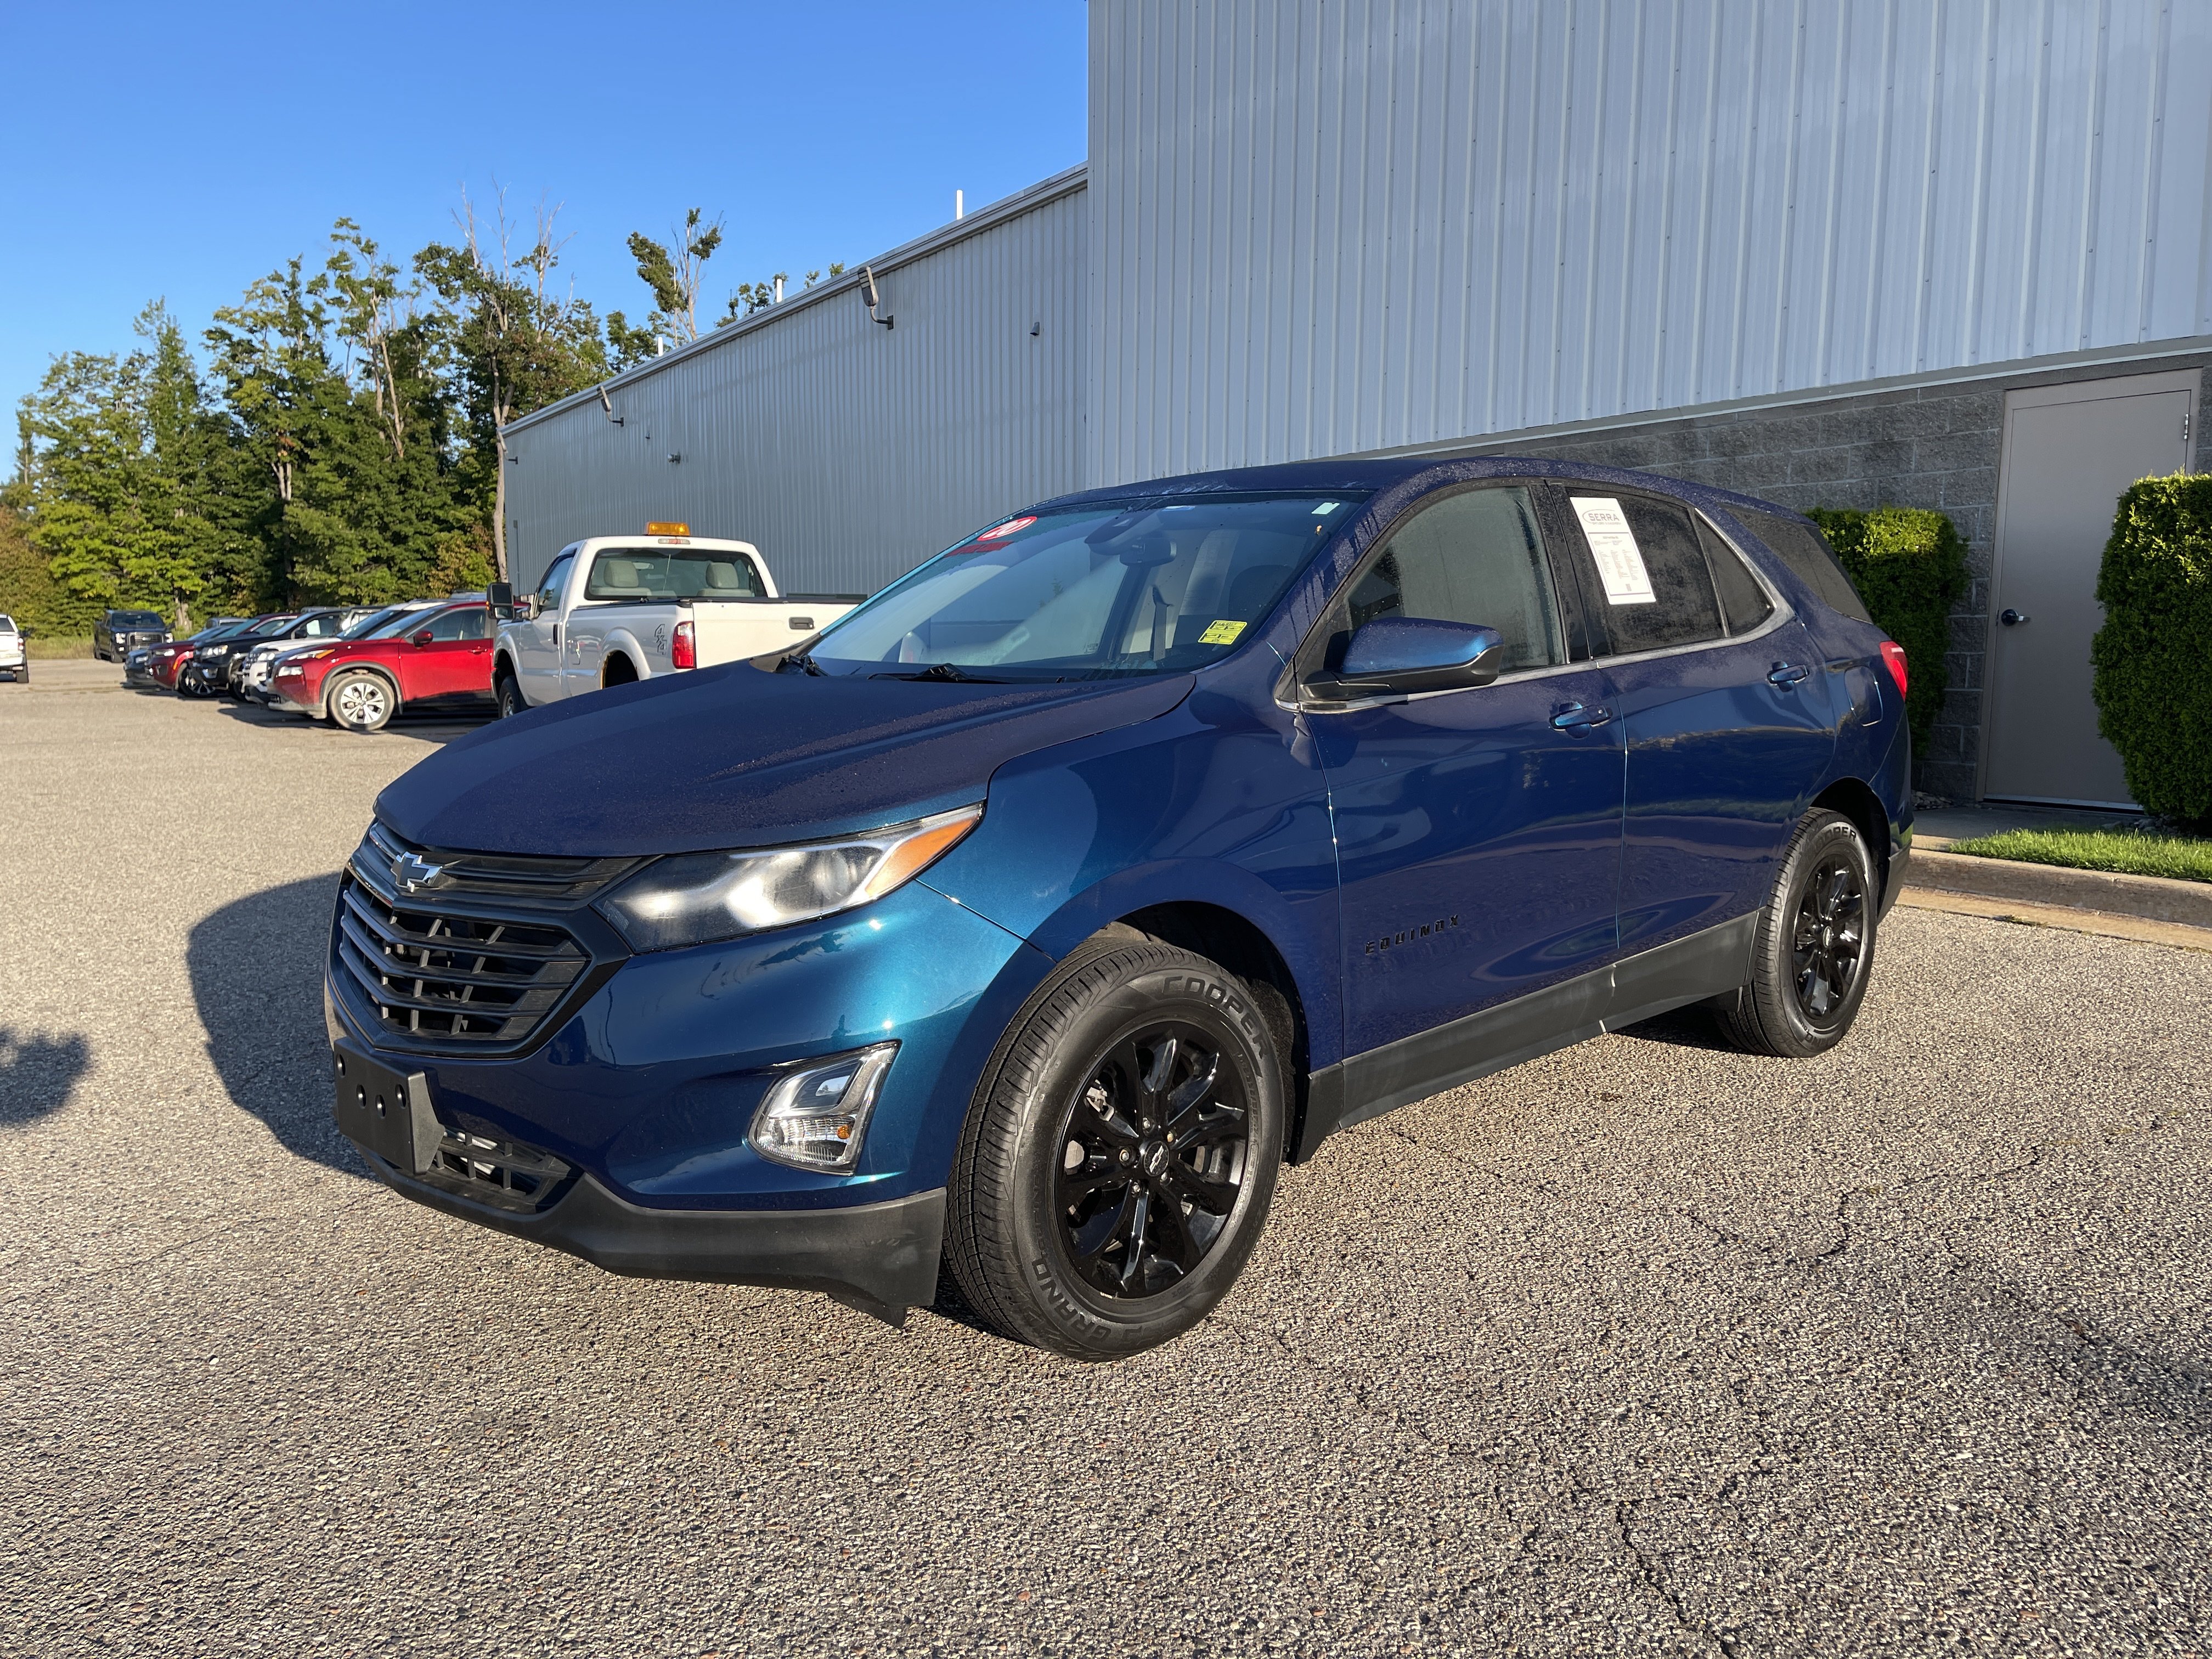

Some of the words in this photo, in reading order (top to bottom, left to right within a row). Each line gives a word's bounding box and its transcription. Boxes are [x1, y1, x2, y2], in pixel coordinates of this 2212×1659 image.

[1588, 513, 1620, 521] SERRA
[1364, 913, 1459, 956] EQUINOX
[1163, 975, 1268, 1059] COOPER
[1031, 1258, 1112, 1341] GRAND
